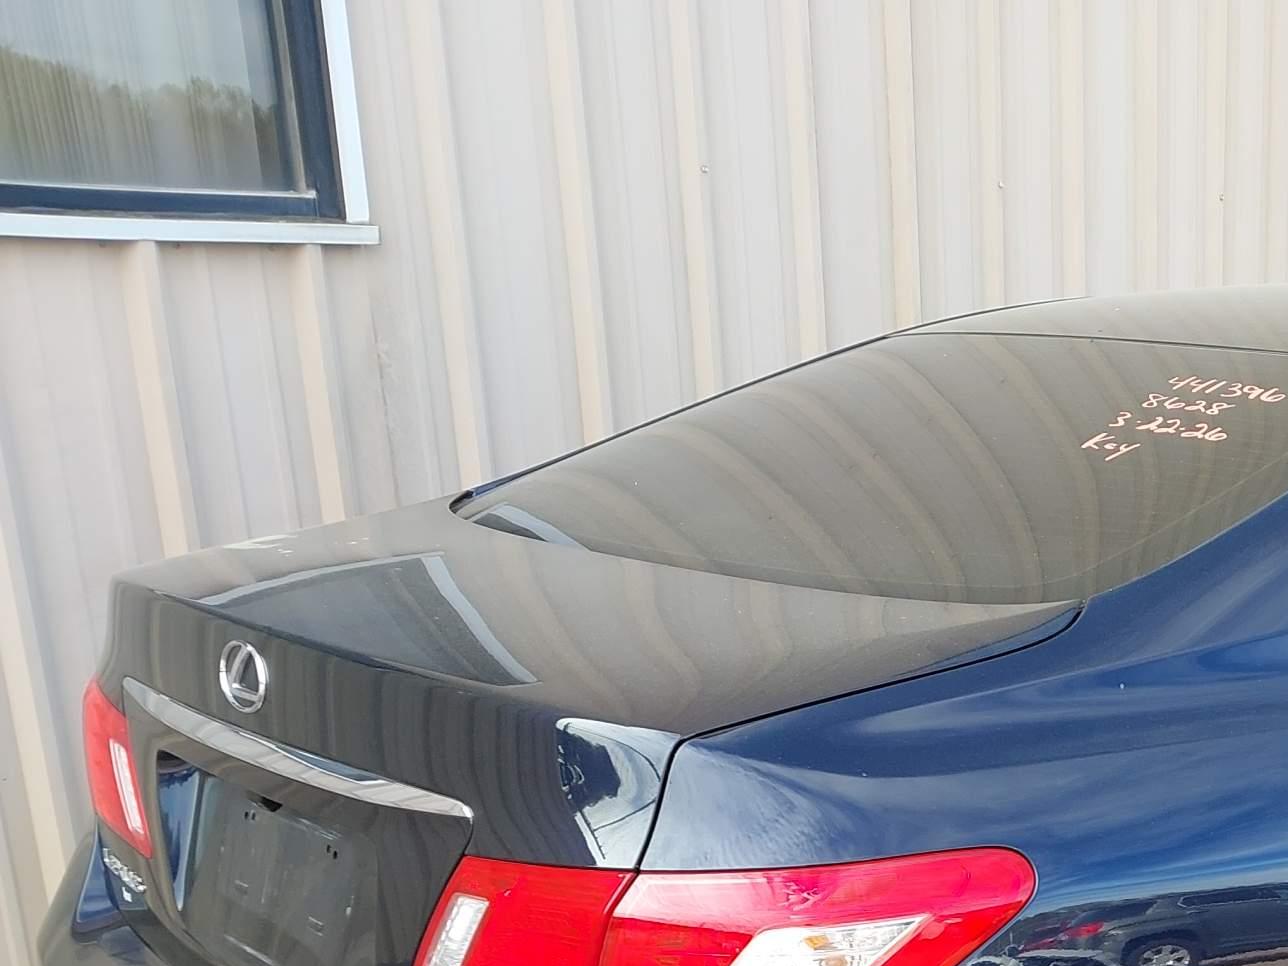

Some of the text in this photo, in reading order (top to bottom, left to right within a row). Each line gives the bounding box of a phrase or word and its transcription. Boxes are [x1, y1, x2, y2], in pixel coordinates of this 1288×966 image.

[1168, 375, 1287, 403] 441396
[1141, 393, 1237, 416] 8628
[1080, 432, 1142, 462] Key
